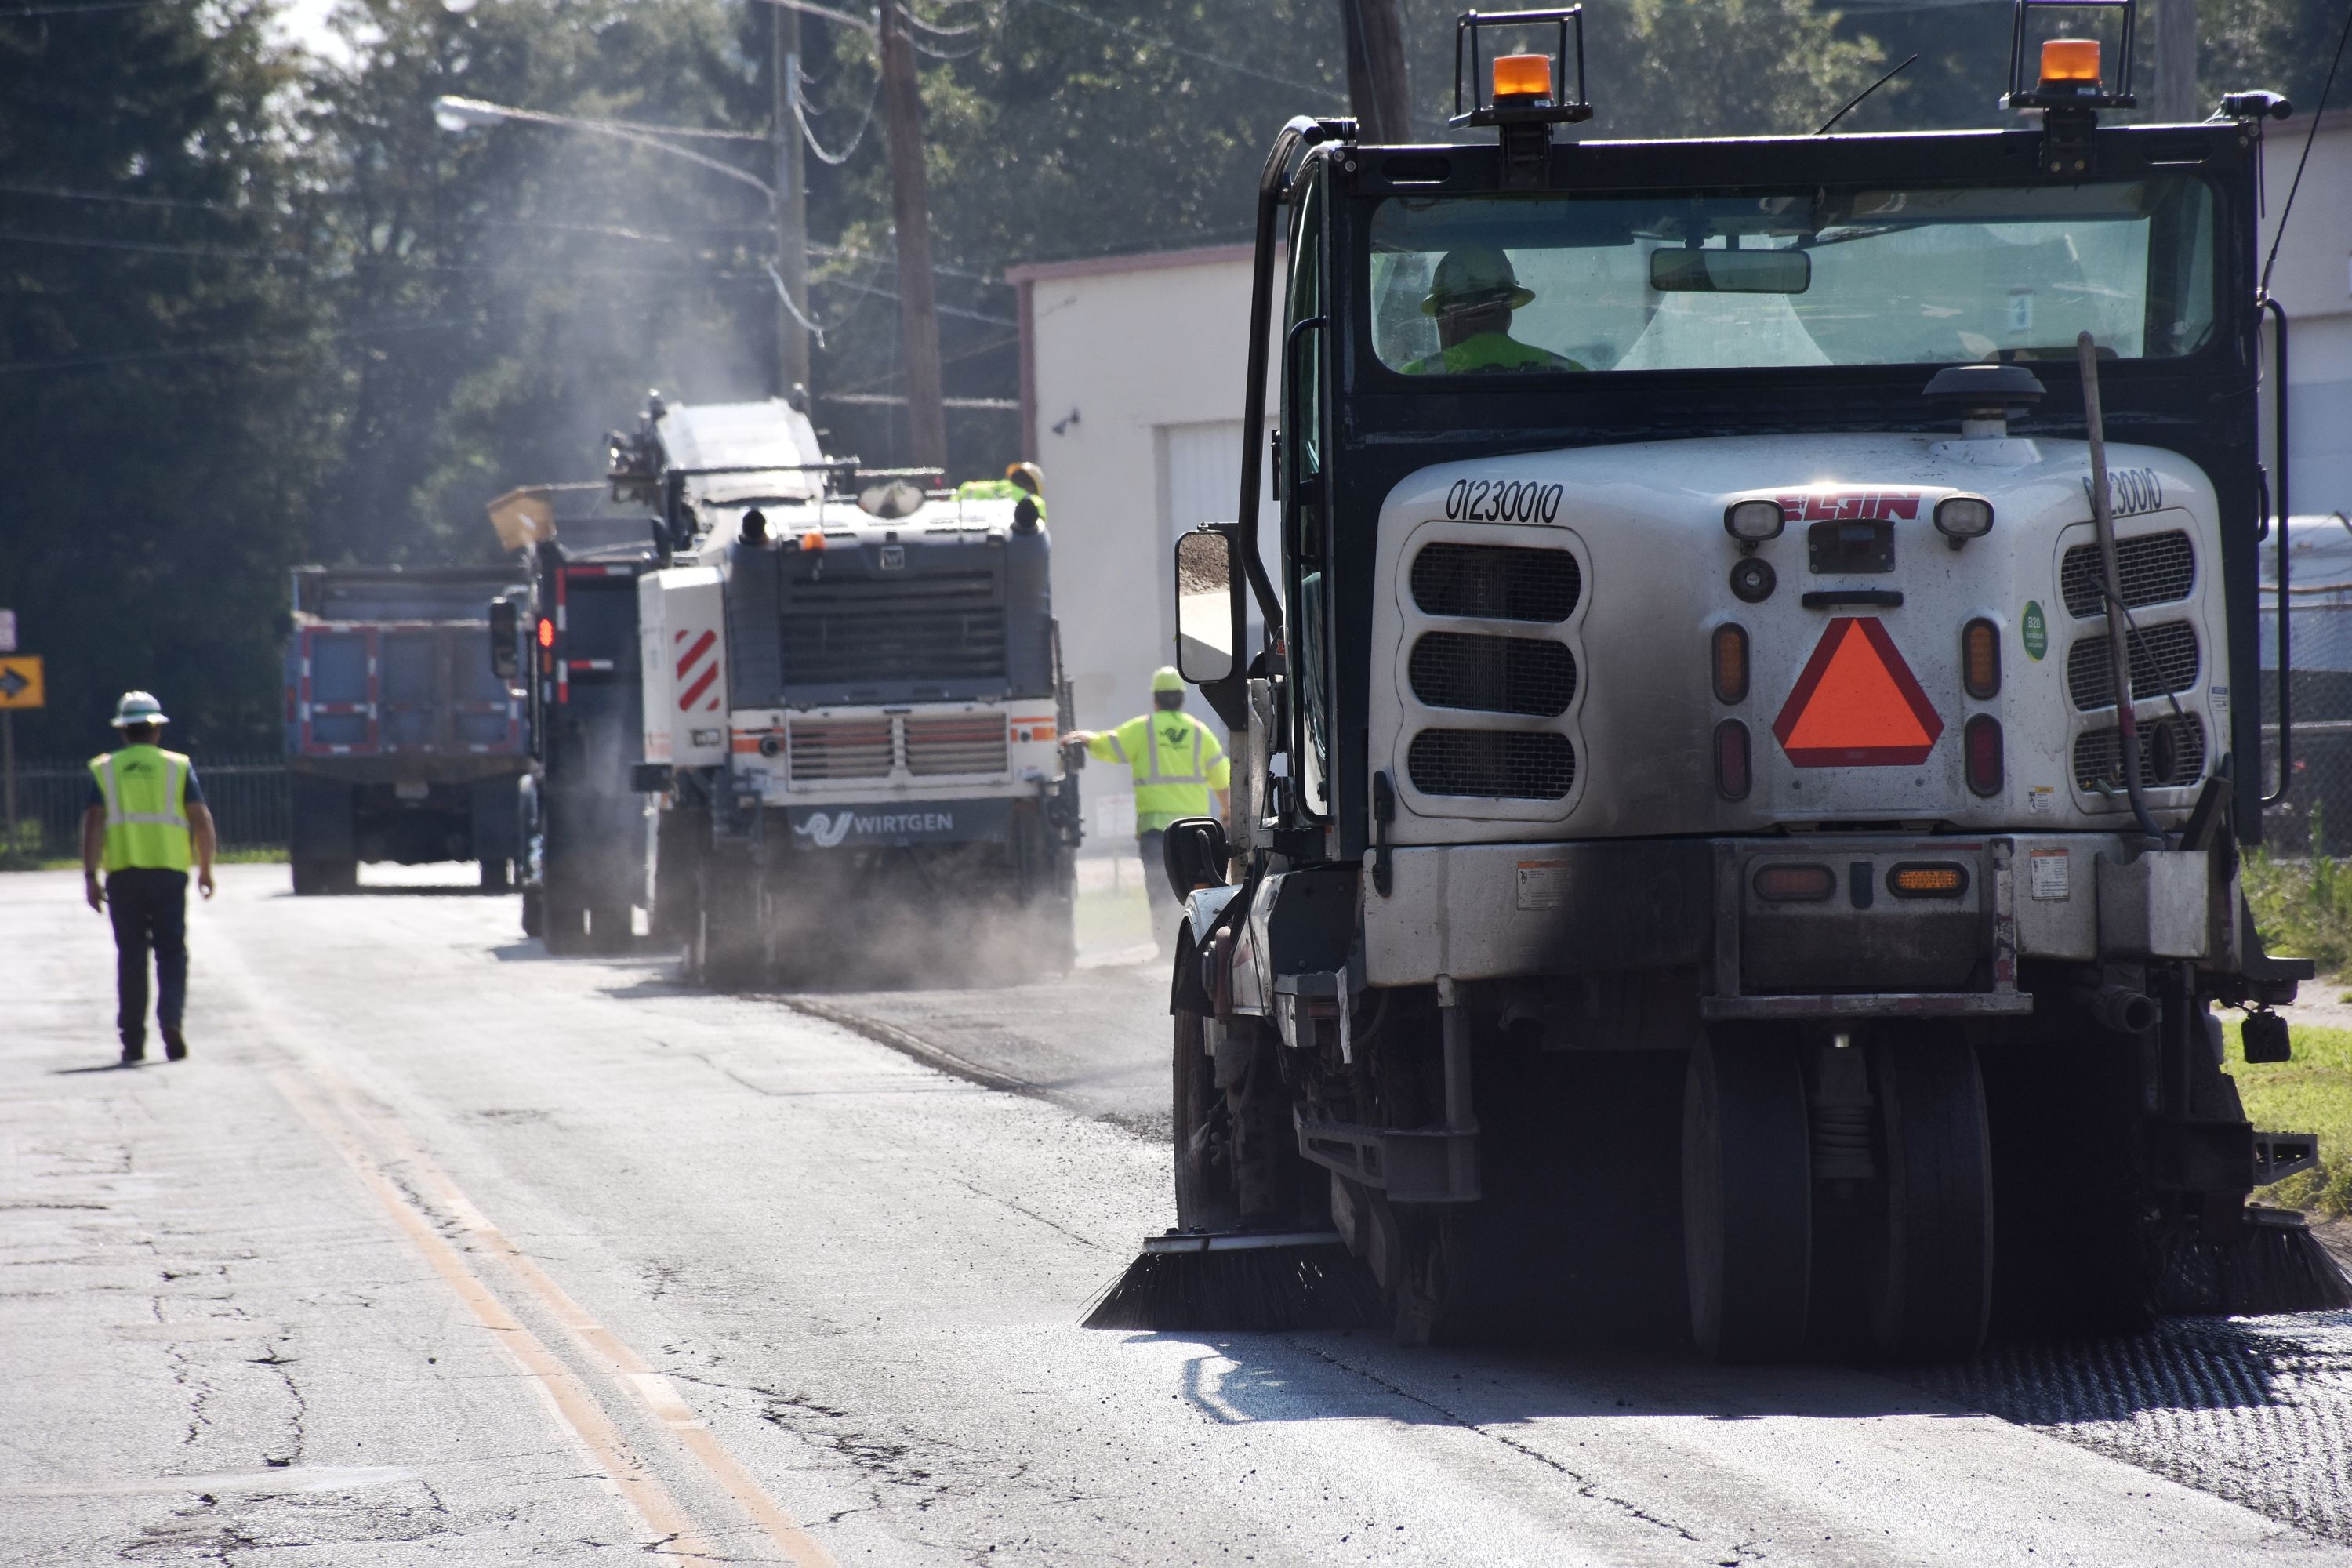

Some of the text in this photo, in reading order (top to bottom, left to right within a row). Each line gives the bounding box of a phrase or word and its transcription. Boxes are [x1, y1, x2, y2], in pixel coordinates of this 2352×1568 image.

[1446, 479, 1563, 524] 01230010
[1776, 490, 1920, 521] ELGIN
[2082, 467, 2161, 515] 030010
[2028, 616, 2041, 629] B20
[855, 813, 953, 834] WIRTGEN
